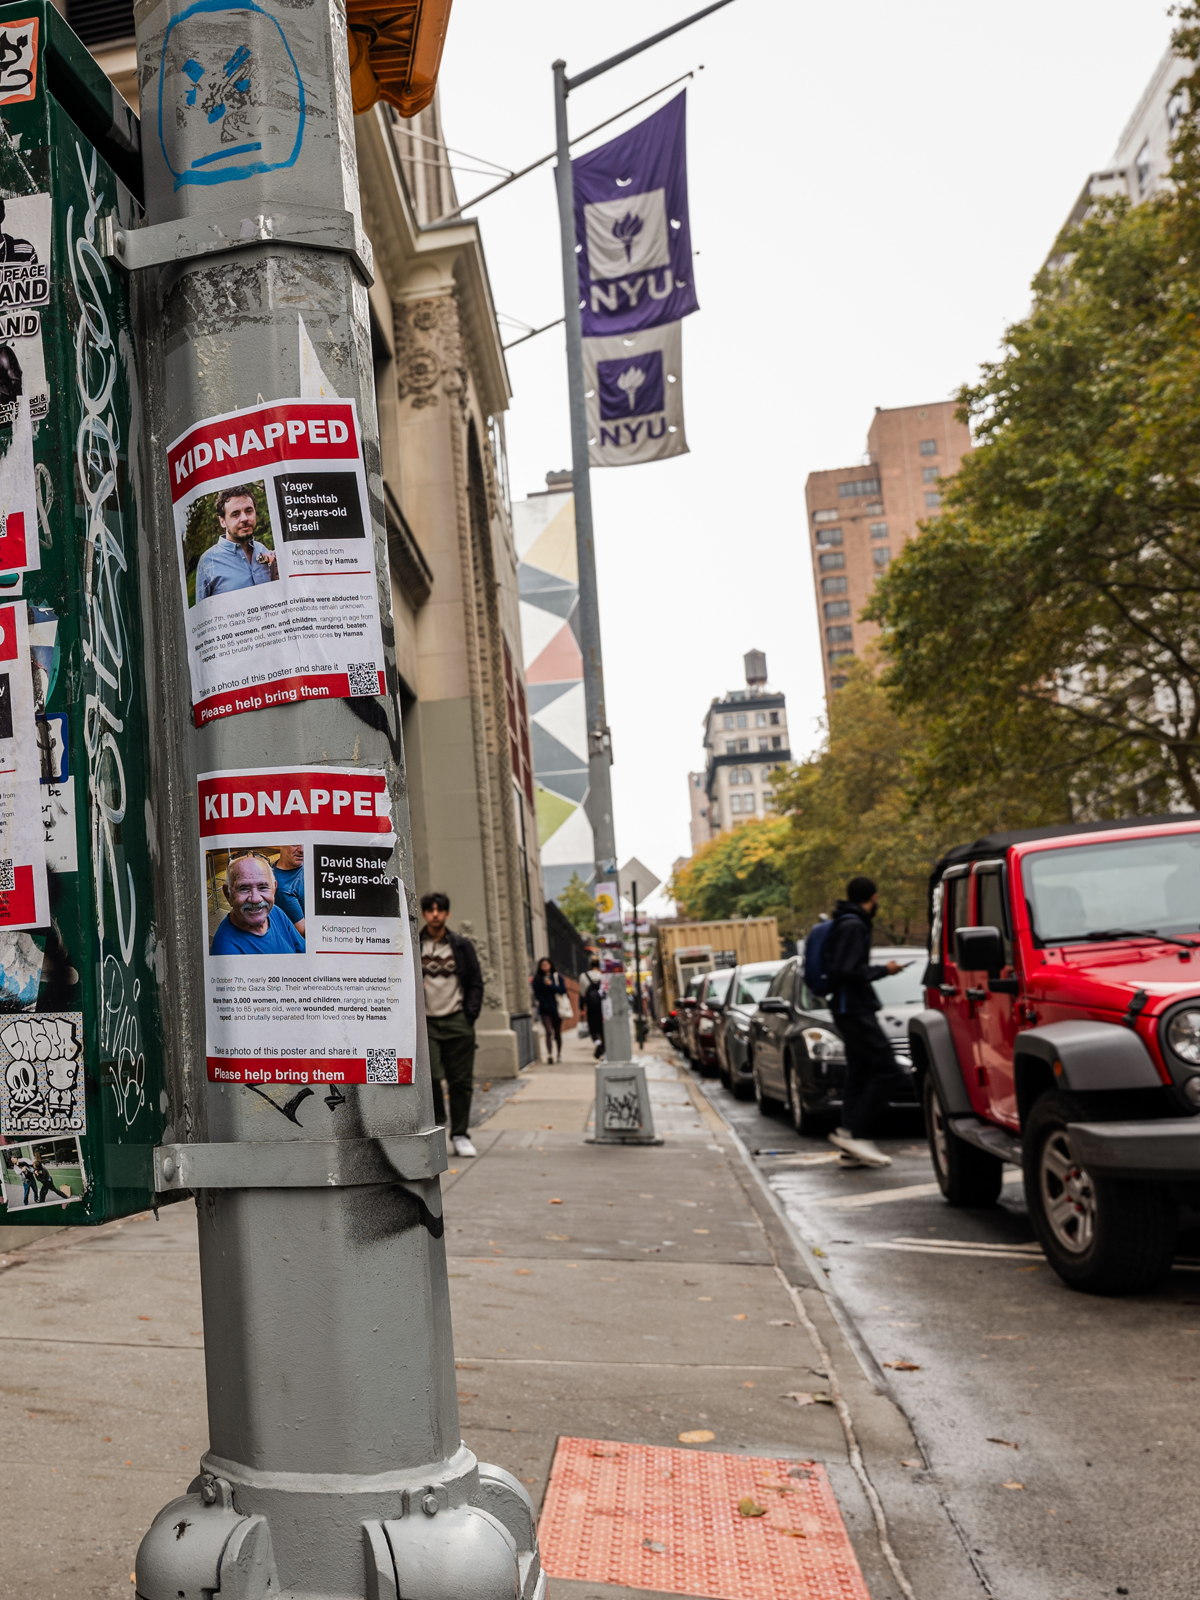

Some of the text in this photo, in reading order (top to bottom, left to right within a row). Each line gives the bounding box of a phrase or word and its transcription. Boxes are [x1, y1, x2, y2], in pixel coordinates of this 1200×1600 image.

[5, 265, 45, 282] PEACE
[590, 269, 674, 314] NYU
[600, 417, 667, 447] NYU
[175, 419, 349, 485] KIDNAPPED
[282, 481, 314, 493] Yagev
[284, 493, 338, 505] Buchshtab
[286, 507, 347, 519] 34-years-old
[288, 521, 320, 532] Israeli
[292, 548, 328, 556] Kidnapped
[217, 680, 240, 691] photo
[242, 677, 249, 685] of
[251, 673, 265, 683] this
[267, 668, 292, 680] poster
[295, 665, 310, 674] and
[311, 664, 332, 672] share
[201, 685, 329, 721] Please help bring them
[321, 856, 352, 868] David
[322, 888, 355, 899] Israeli
[322, 925, 377, 935] Kidnapped from
[322, 935, 390, 945] his home by Hamas
[230, 1047, 251, 1057] photo
[254, 1047, 262, 1055] of
[263, 1047, 278, 1055] this
[281, 1048, 307, 1057] poster
[309, 1047, 325, 1055] and
[328, 1047, 350, 1055] share
[352, 1047, 358, 1055] it
[215, 1068, 345, 1082] Please help bring them
[5, 1117, 83, 1130] HITSQUAD
